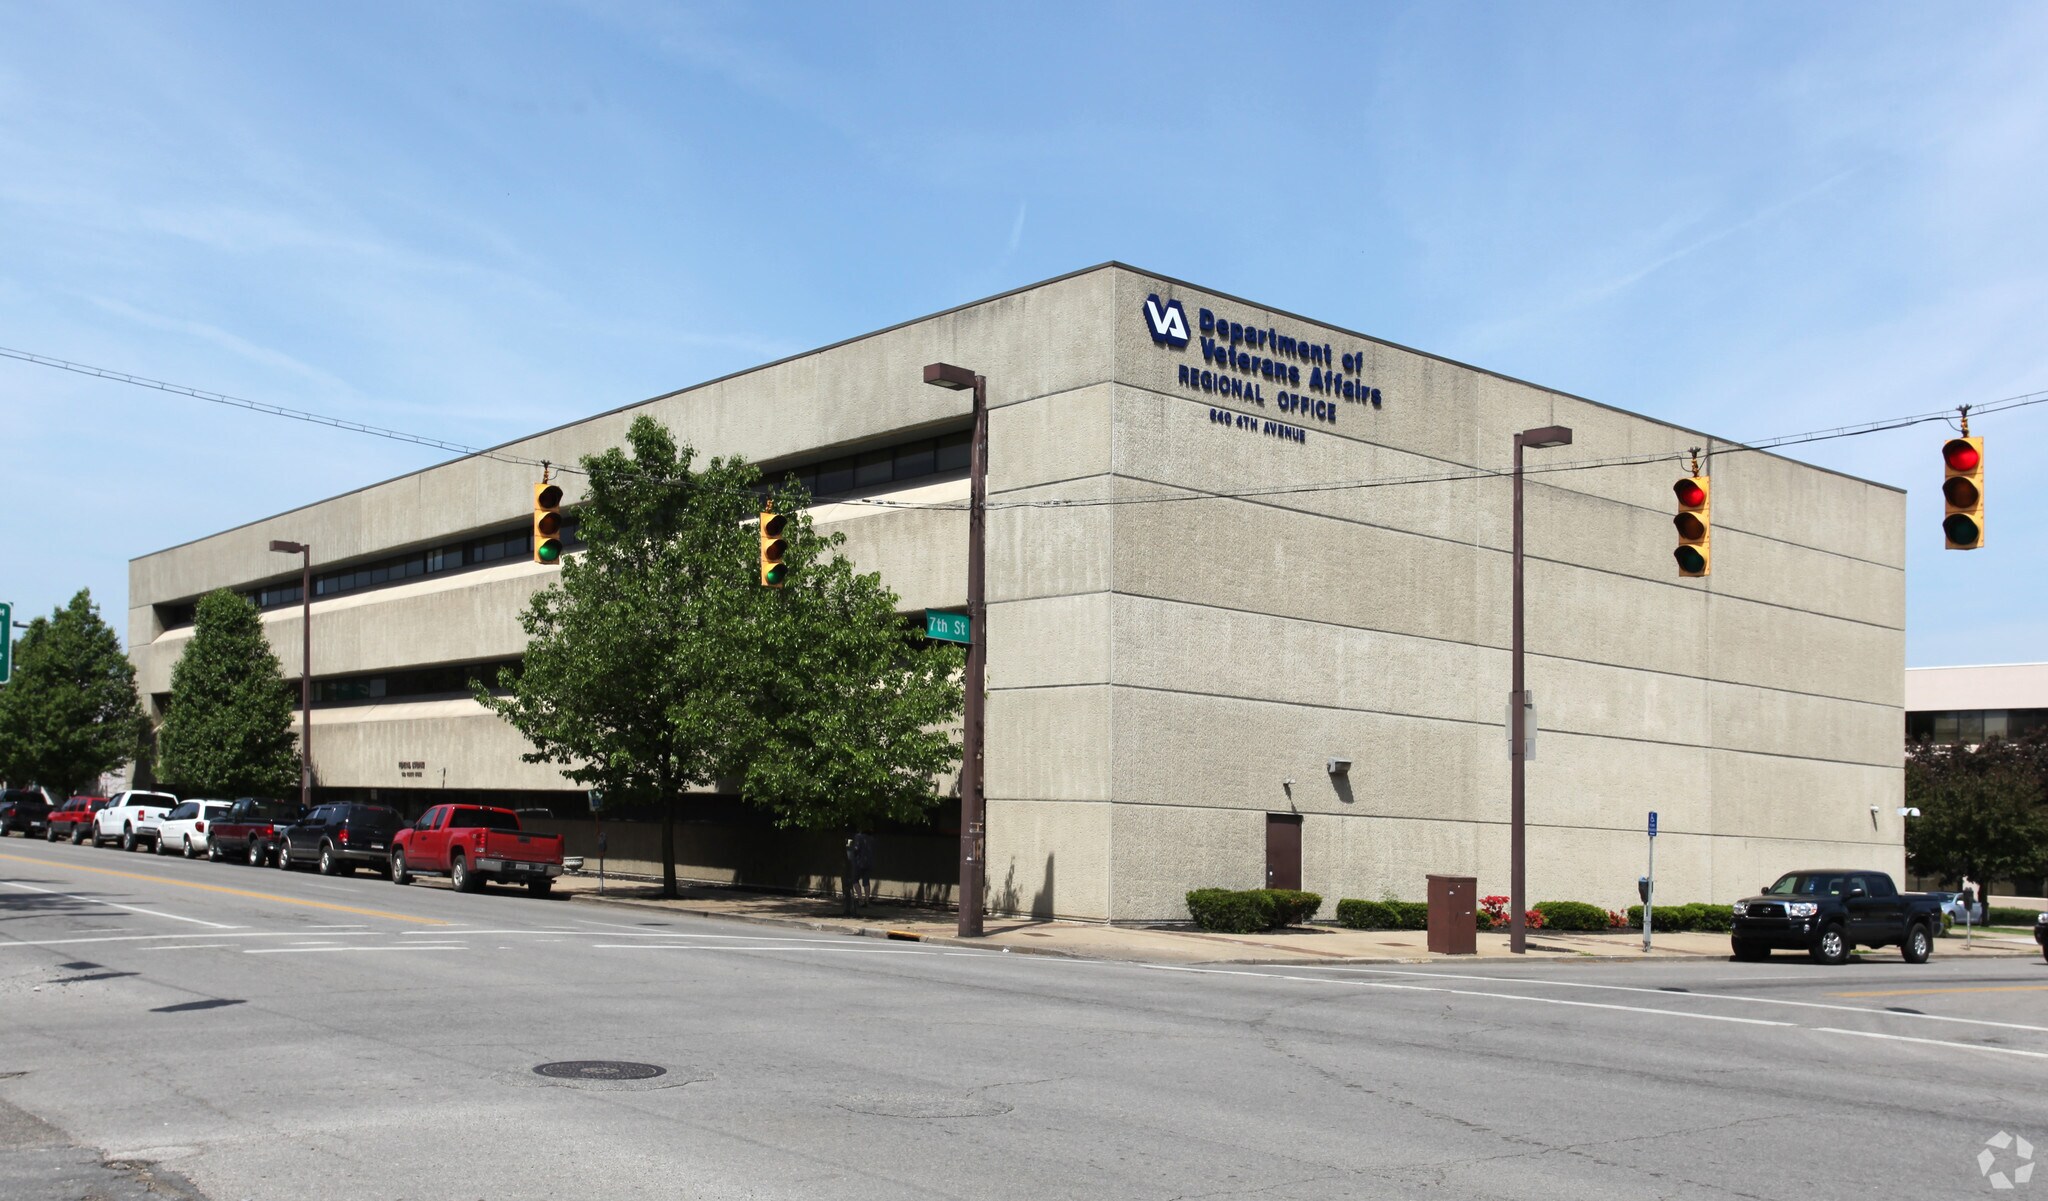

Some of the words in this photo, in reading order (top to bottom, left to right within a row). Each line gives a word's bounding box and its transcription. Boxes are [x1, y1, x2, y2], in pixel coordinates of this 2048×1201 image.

[1146, 299, 1189, 341] VA
[1199, 308, 1332, 364] Department
[1341, 351, 1363, 372] of
[1178, 364, 1264, 402] REGIONAL
[1277, 391, 1336, 422] OFFICE
[1200, 336, 1300, 383] Veterans
[1309, 367, 1382, 405] Affairs
[1236, 415, 1258, 431] 4TH
[1263, 421, 1305, 443] AVENUE
[929, 616, 948, 633] 7th
[954, 620, 966, 636] St
